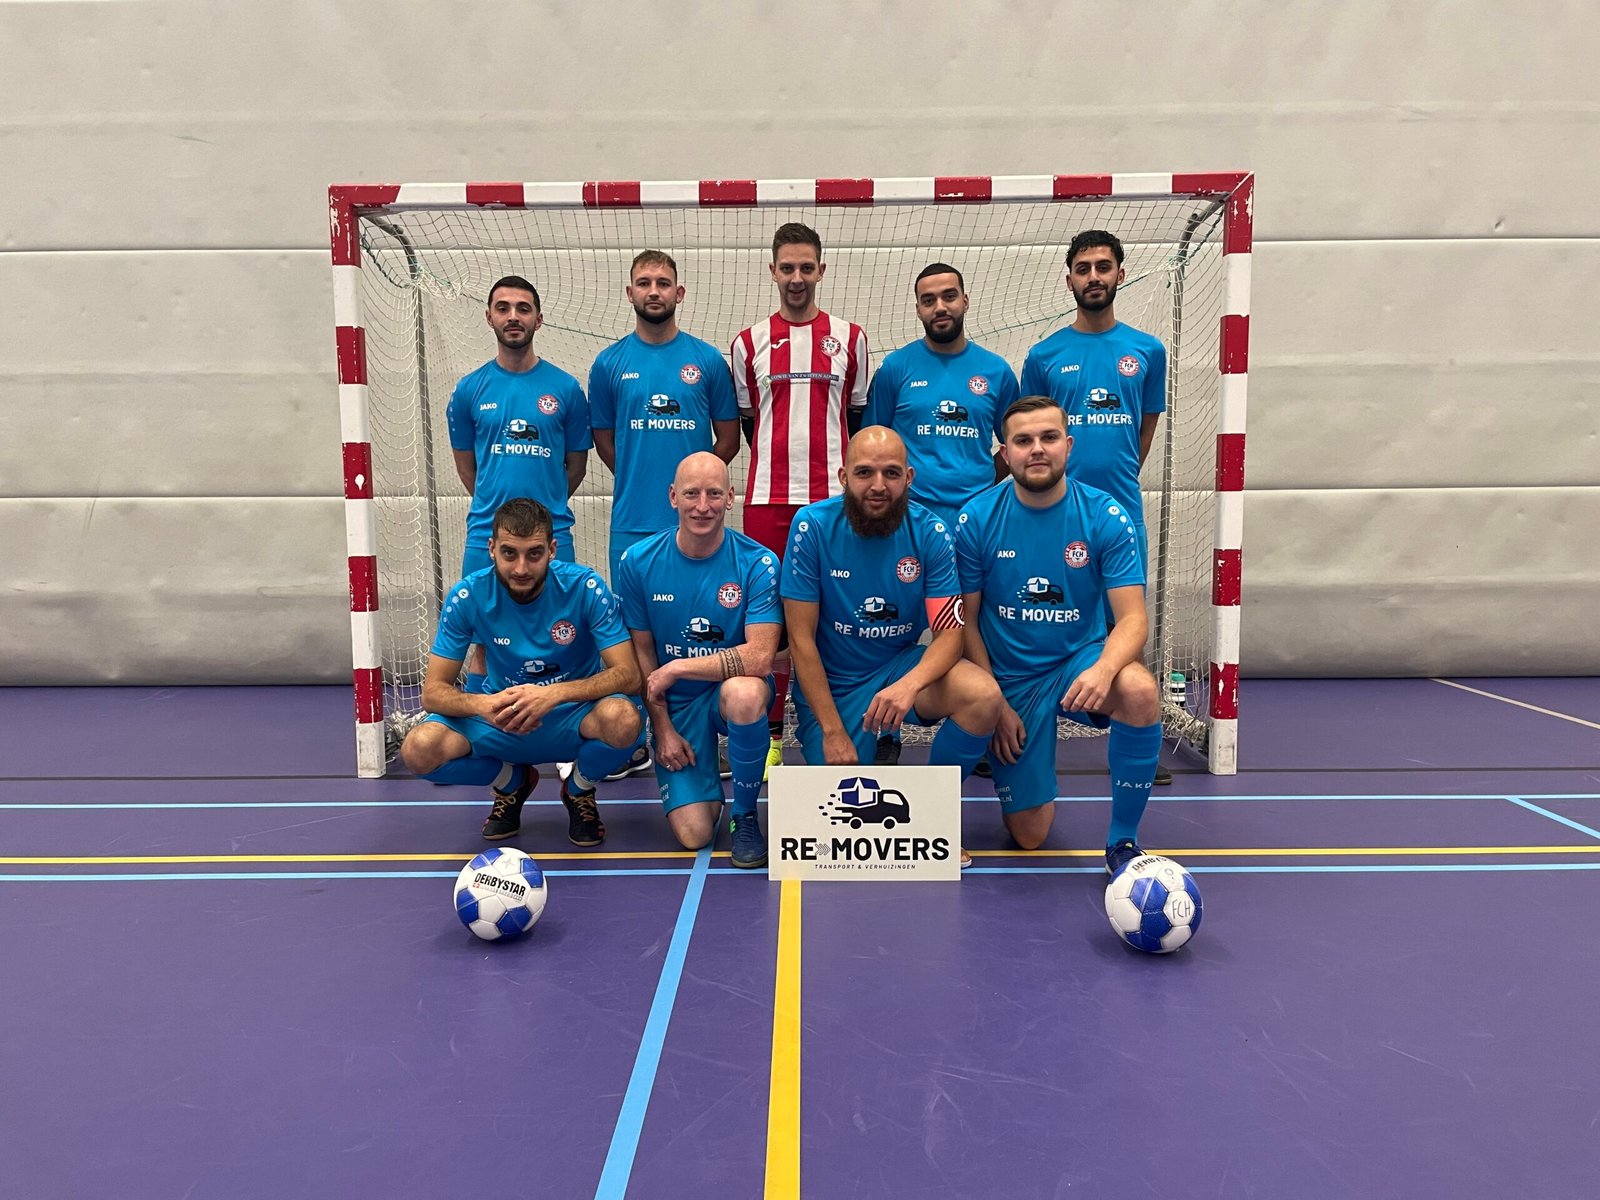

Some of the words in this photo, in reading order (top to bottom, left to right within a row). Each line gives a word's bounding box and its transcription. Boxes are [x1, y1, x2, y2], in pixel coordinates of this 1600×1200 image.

[1061, 364, 1080, 373] JAKO
[621, 372, 640, 380] JAKO
[910, 380, 928, 388] JAKO
[480, 402, 498, 411] JAKO
[630, 419, 644, 430] RE
[648, 419, 696, 430] MOVERS
[1067, 414, 1083, 426] RE
[1087, 413, 1133, 425] MOVERS
[917, 424, 931, 435] RE
[935, 424, 979, 439] MOVERS
[505, 443, 551, 458] MOVERS
[997, 550, 1016, 558] AKO
[1072, 550, 1084, 558] FCH
[830, 569, 850, 579] AKO
[903, 565, 915, 573] FCH
[652, 594, 674, 602] JAKO
[998, 605, 1016, 620] RE
[1022, 608, 1080, 623] MOVERS
[834, 621, 853, 636] RE
[859, 622, 913, 639] MOVERS
[493, 637, 511, 646] AKO
[665, 643, 682, 657] RE
[1115, 779, 1152, 789] JAKO
[781, 837, 817, 861] RE
[831, 837, 950, 862] MOVERS
[474, 872, 526, 897] DERBYSTAR
[1171, 899, 1191, 919] FCH
